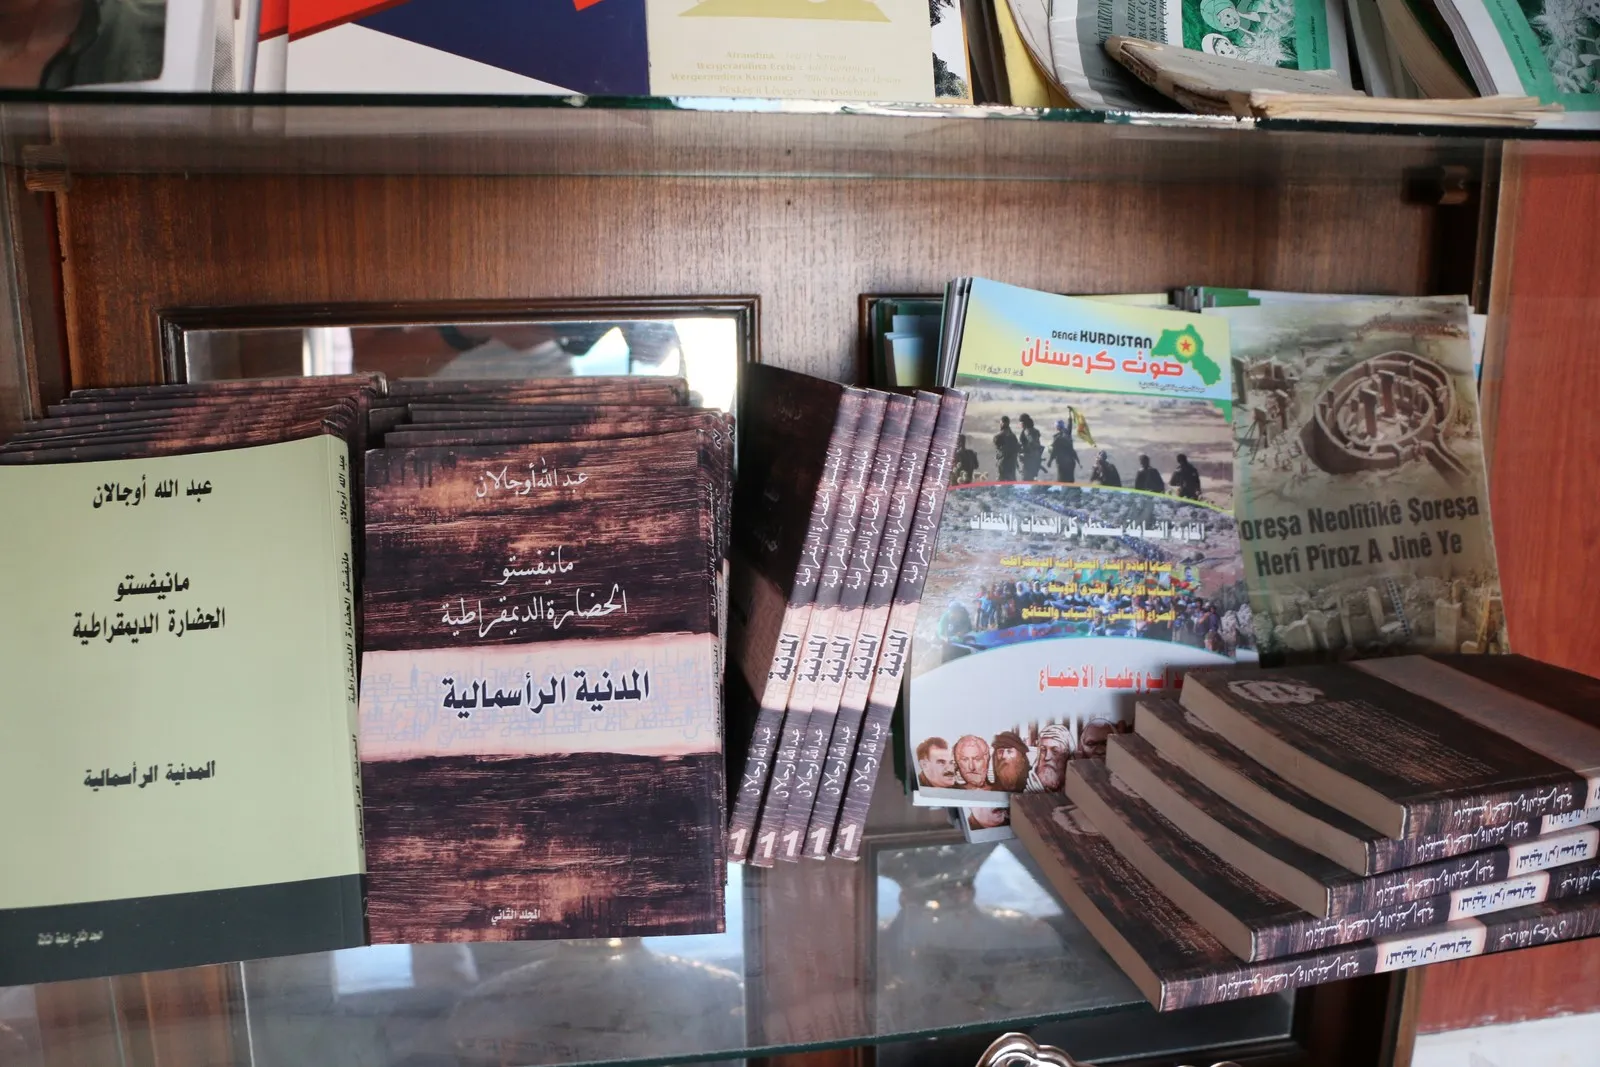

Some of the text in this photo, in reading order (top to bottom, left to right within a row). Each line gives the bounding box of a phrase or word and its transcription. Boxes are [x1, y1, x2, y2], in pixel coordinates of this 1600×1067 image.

[1052, 330, 1152, 349] DENGÊ KURDISTAN
[1022, 337, 1115, 374] كردستان
[1122, 351, 1183, 379] صوت
[93, 474, 213, 509] عبد الله أوجالان
[476, 457, 589, 497] عبد الله أوجالان
[1064, 516, 1078, 539] كل
[1238, 496, 1479, 543] oreşa Neolîtîkê Şoreşa
[496, 545, 574, 585] مانيفستو
[1255, 547, 1300, 577] Herî
[1306, 543, 1362, 571] Pîroz
[1367, 538, 1383, 563] A
[1437, 530, 1462, 554] Ye
[114, 571, 190, 602] مانيفستو
[73, 606, 225, 645] الحضارة الديمقراطية
[441, 584, 627, 638] الحضارة الديمقراطية
[768, 633, 799, 682] المدنية
[797, 634, 828, 683] المدنية
[820, 635, 851, 684] المدنية
[845, 632, 879, 682] المدنية
[878, 629, 908, 678] المدنية
[1039, 664, 1094, 692] الاجتماع
[1100, 665, 1141, 694] وعلماء
[442, 669, 650, 719] المدنية الرأسمالية
[762, 727, 776, 744] عبد
[791, 728, 805, 746] عبد
[814, 729, 828, 746] عبد
[841, 726, 855, 743] عبد
[872, 722, 886, 740] عبد
[84, 760, 216, 792] المدنية الرأسمالية
[730, 828, 747, 855] 1
[760, 832, 776, 858] 1
[783, 830, 799, 857] 1
[811, 827, 826, 854] 1
[841, 824, 857, 851] 1
[1516, 840, 1588, 869] المدنية الرأسمالية
[1458, 882, 1537, 911] المدنية الرأسمالية
[491, 907, 541, 925] المجلد الثاني
[1385, 937, 1472, 966] المدنية الرأسمالية
